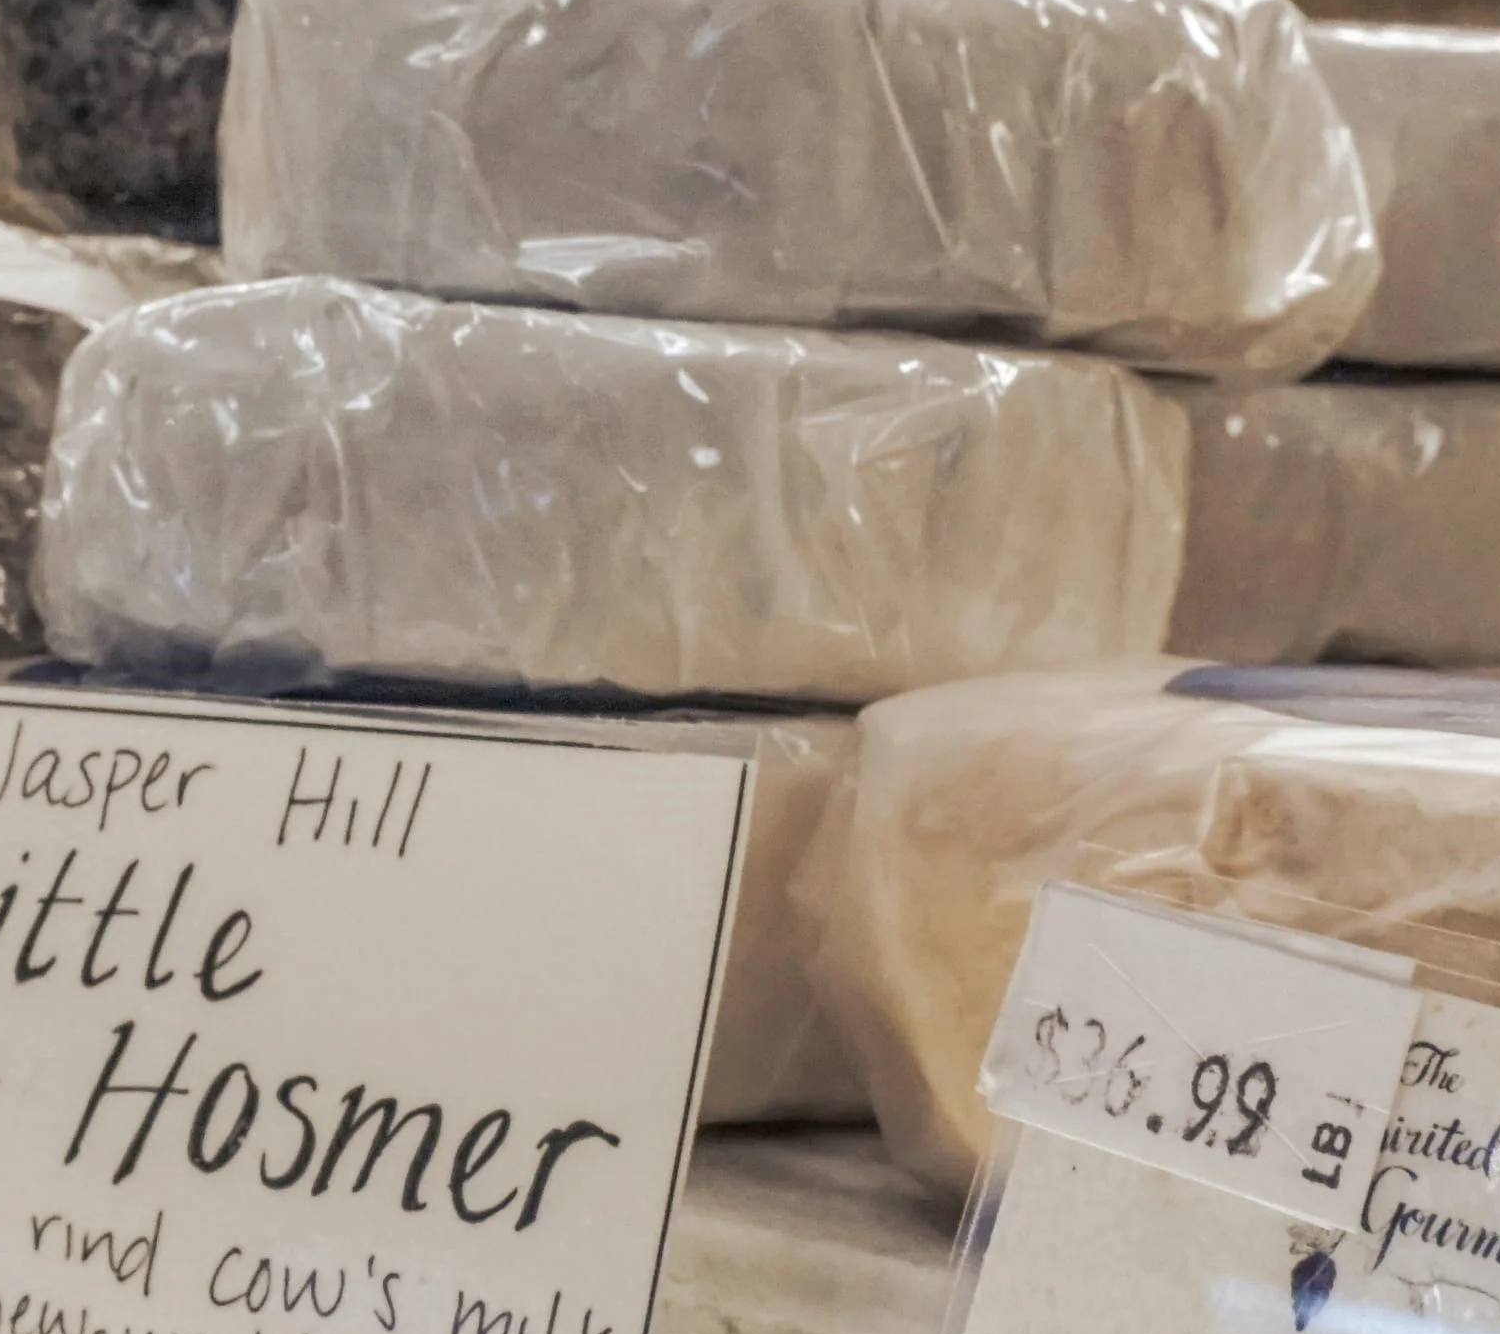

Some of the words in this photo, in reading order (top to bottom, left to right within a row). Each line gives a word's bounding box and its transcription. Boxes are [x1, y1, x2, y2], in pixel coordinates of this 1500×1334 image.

[275, 745, 435, 860] Hill
[64, 1019, 620, 1232] Hosmer
[1399, 1039, 1463, 1095] The
[30, 1209, 165, 1297] rind
[208, 1247, 402, 1331] cow's
